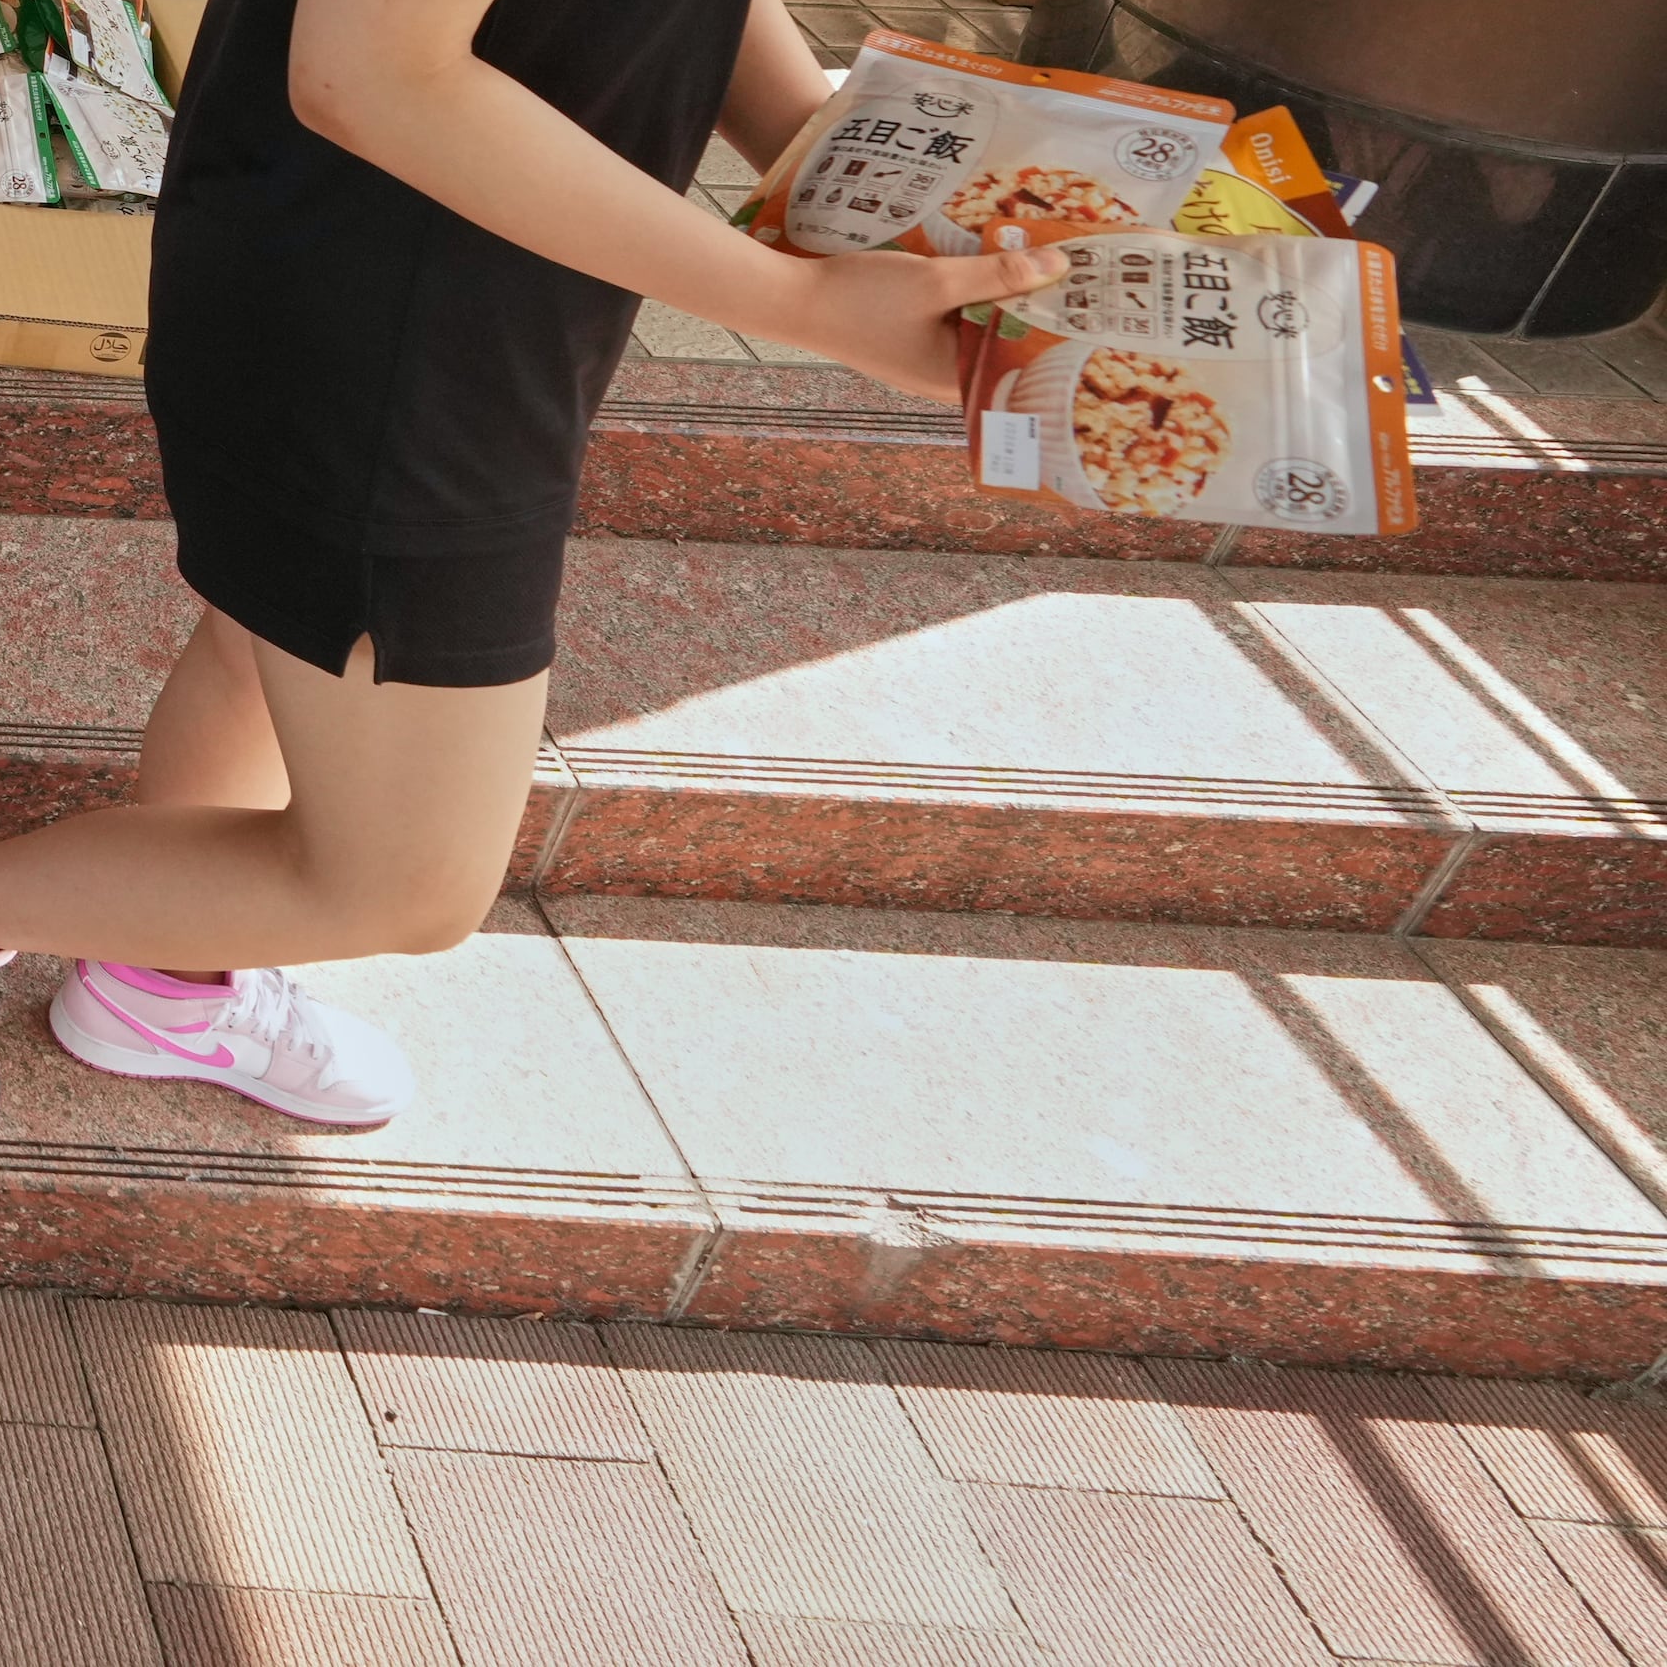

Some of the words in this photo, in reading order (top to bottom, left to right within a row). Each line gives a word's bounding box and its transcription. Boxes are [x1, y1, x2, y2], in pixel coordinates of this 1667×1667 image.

[913, 92, 975, 119] 安心米
[1149, 92, 1223, 117] アルファ化米
[831, 117, 975, 165] 五目ご飯
[1131, 137, 1176, 164] 28
[1249, 132, 1292, 185] Onisi
[12, 174, 28, 191] 28
[1182, 249, 1237, 350] 五目ご飯
[1287, 470, 1326, 506] 28
